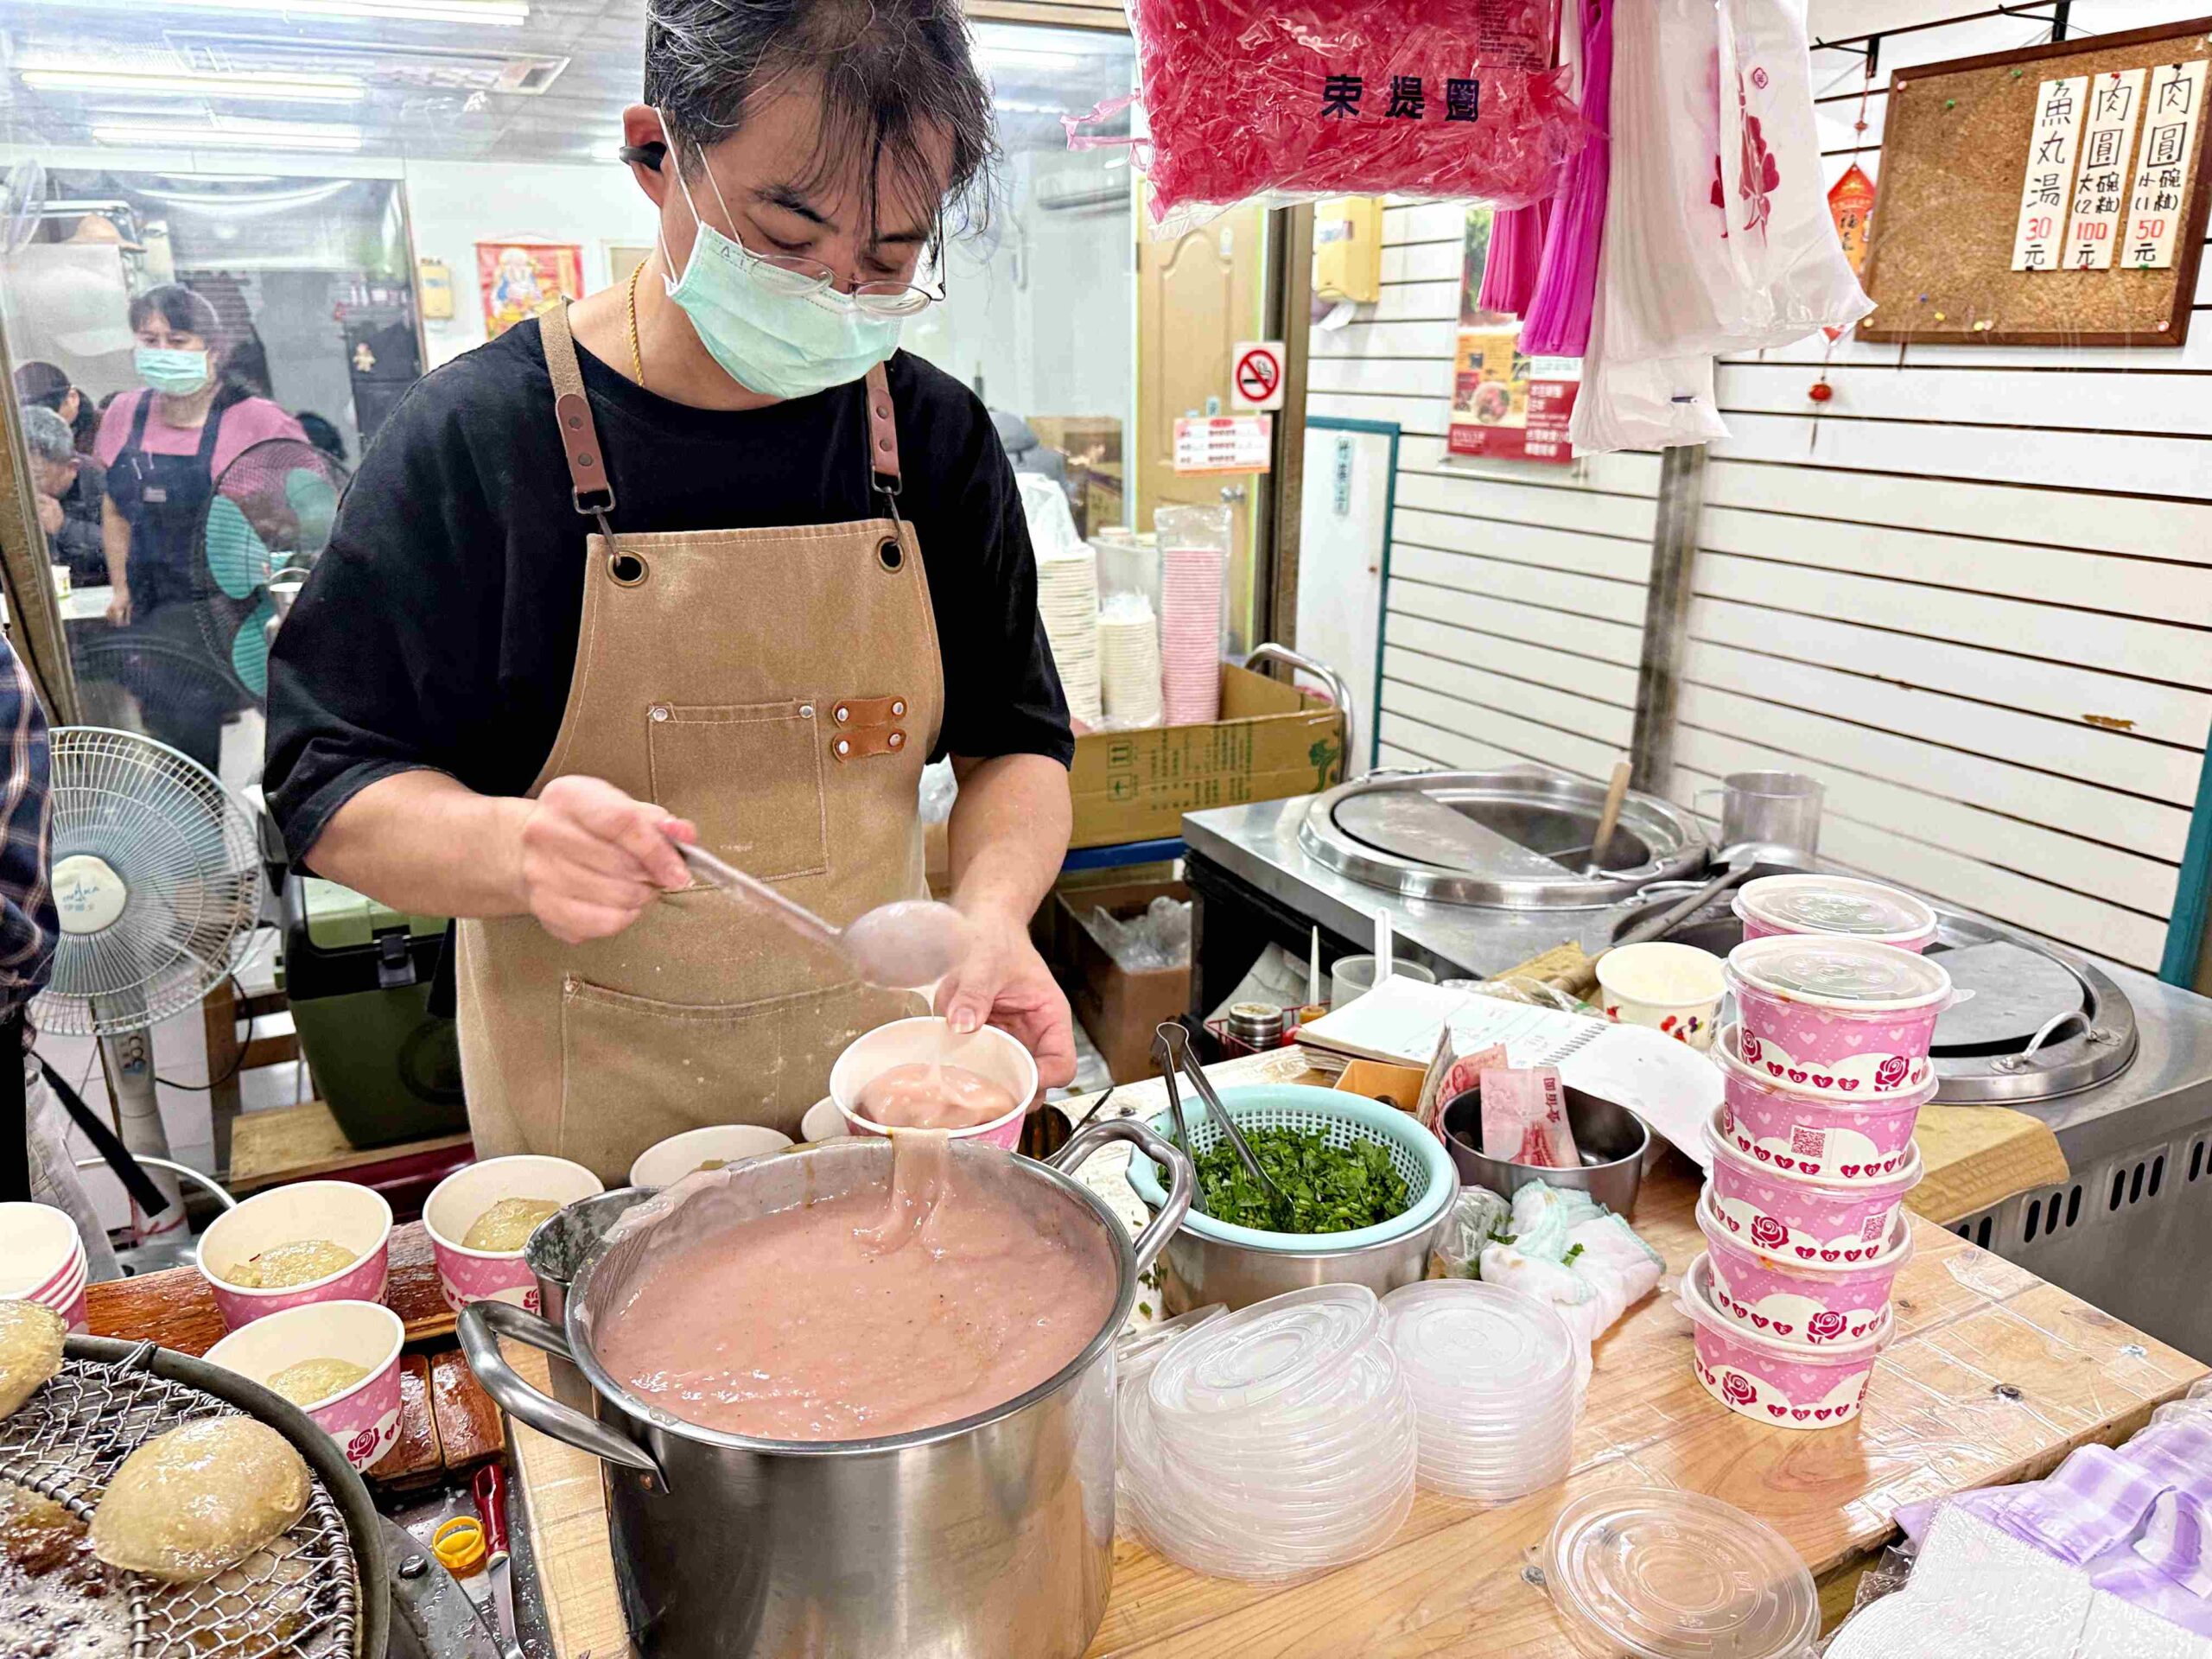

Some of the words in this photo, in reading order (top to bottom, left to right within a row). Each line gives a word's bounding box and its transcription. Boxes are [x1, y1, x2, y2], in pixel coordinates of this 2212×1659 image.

[2025, 216, 2052, 241] 30
[1770, 1064, 1856, 1090] LOVE
[1738, 1137, 1817, 1174] LOVE
[1798, 1246, 1877, 1262] LOVE
[1720, 1294, 1791, 1334] LOVE
[1770, 1406, 1847, 1421] LOVE
